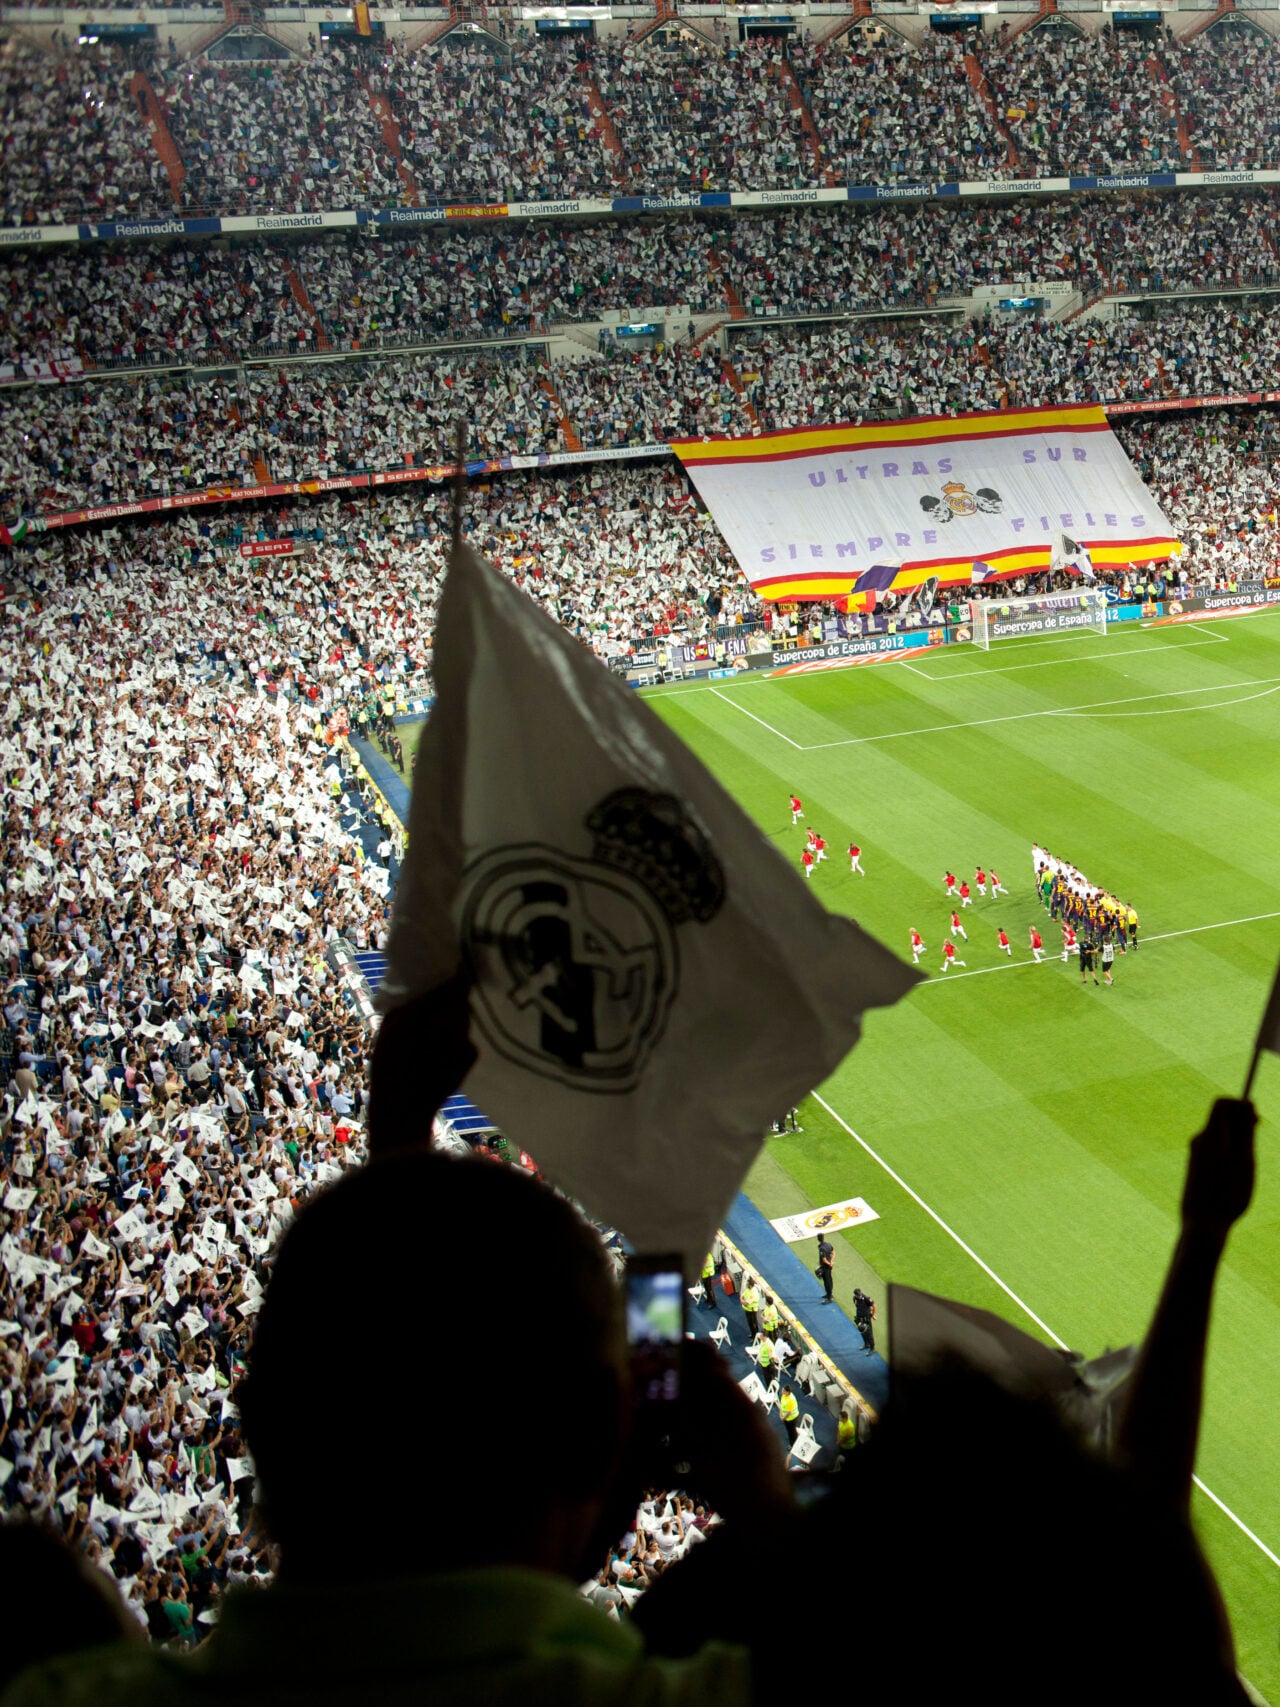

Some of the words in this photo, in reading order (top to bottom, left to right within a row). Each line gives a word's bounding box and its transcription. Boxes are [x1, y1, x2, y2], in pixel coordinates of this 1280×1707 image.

[1096, 176, 1149, 188] Realmadrid
[1203, 172, 1254, 184] Realmadrid
[876, 185, 931, 198] Realmadrid
[988, 181, 1041, 193] Realmadrid
[761, 191, 818, 203] Realmadrid
[390, 208, 446, 222] Realmadri
[520, 202, 580, 215] Realmadrid
[256, 215, 323, 229] Realmadrid
[1111, 404, 1138, 413] SEAT
[1202, 397, 1226, 408] Estrella
[808, 457, 953, 488] ULTRAS
[1022, 447, 1088, 464] SUR
[388, 471, 420, 481] SEAT
[325, 477, 353, 491] Damm
[175, 494, 209, 505] SEAT
[243, 489, 264, 497] TOLEDO
[87, 507, 117, 520] Estrella
[117, 503, 143, 517] Damm
[760, 529, 938, 564] SIEMPRE
[1010, 512, 1147, 534] FIELES
[255, 542, 292, 554] SEAT
[1196, 588, 1212, 599] old
[1237, 582, 1262, 593] faces
[1204, 594, 1252, 610] Supercopa
[1253, 591, 1265, 603] de
[993, 619, 1043, 635] Supercopa
[1045, 617, 1058, 628] de
[1058, 612, 1093, 626] España
[683, 646, 697, 662] US
[773, 648, 825, 664] Supercopa
[826, 645, 840, 656] de
[841, 638, 877, 654] España
[879, 635, 905, 649] 2012
